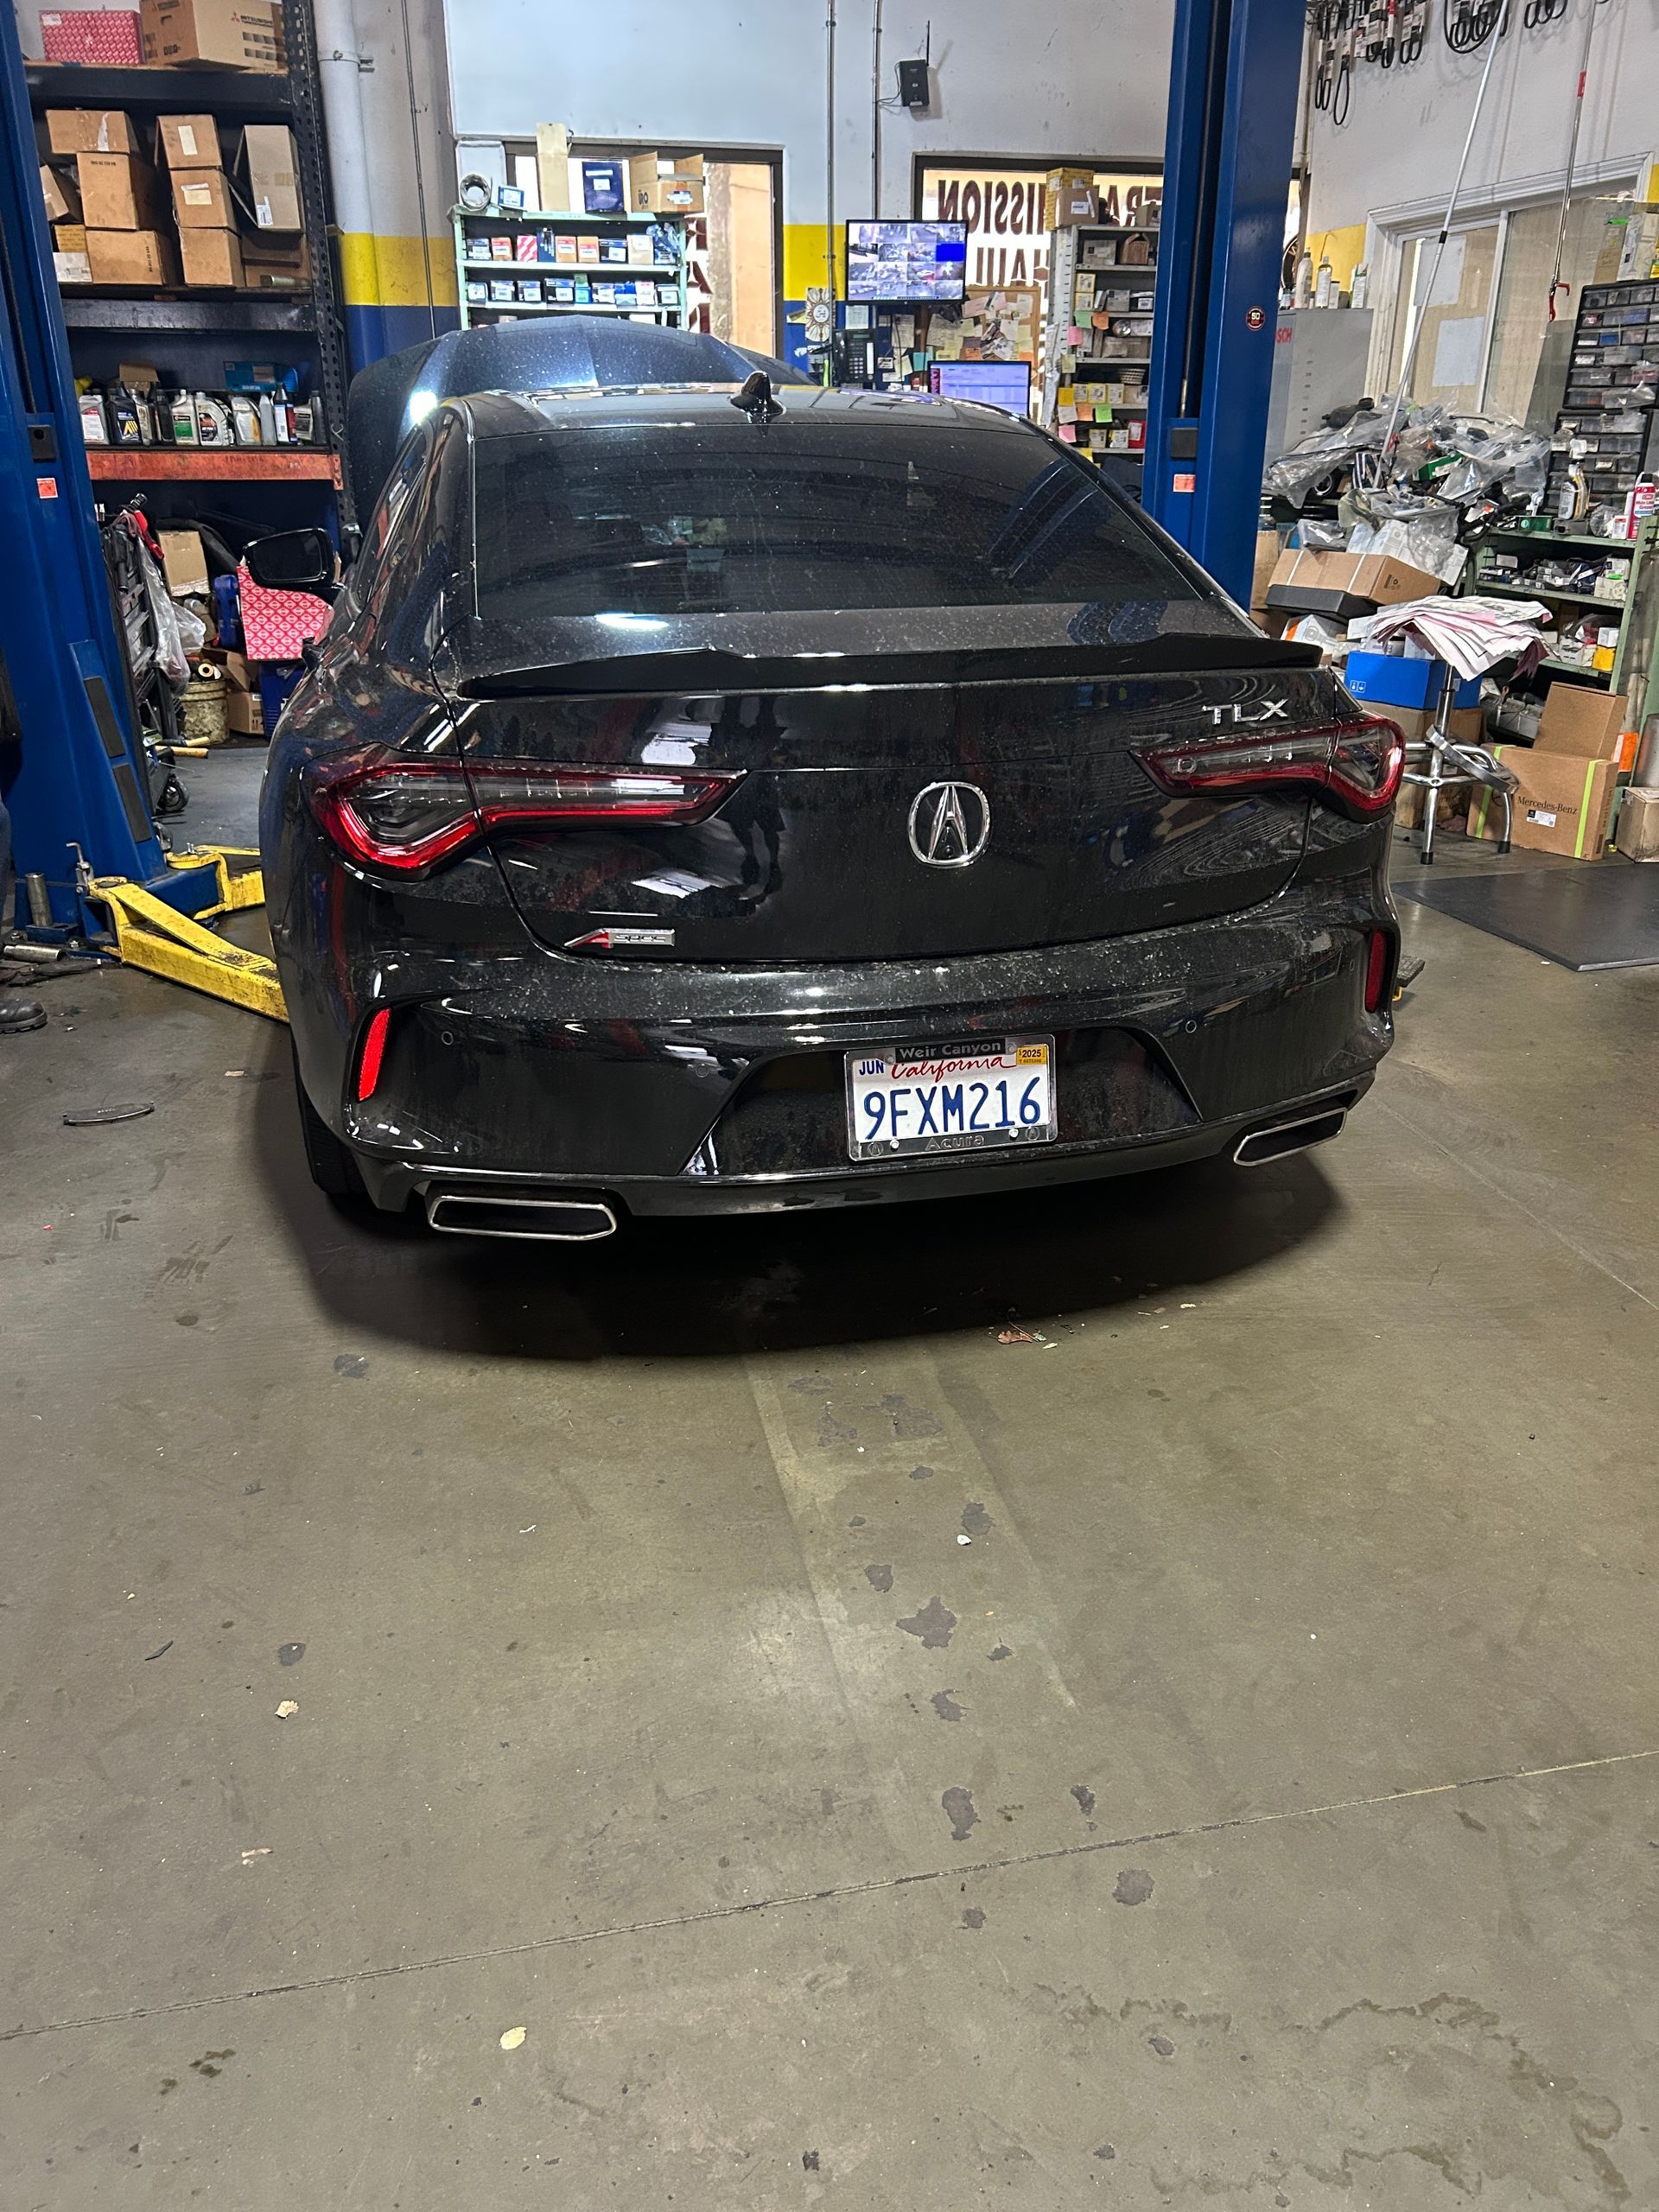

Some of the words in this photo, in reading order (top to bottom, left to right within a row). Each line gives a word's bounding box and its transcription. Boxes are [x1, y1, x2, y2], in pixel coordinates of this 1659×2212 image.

[1276, 327, 1293, 344] SCH
[1202, 698, 1289, 725] TLX
[1517, 795, 1578, 815] Mercedes-Benz
[899, 1046, 937, 1059] Weir
[941, 1041, 1001, 1057] Canyon
[1022, 1049, 1042, 1058] 2025
[859, 1060, 885, 1076] JUN
[891, 1056, 1017, 1083] California
[864, 1077, 1040, 1140] 9FXM216
[925, 1134, 985, 1152] Acura
